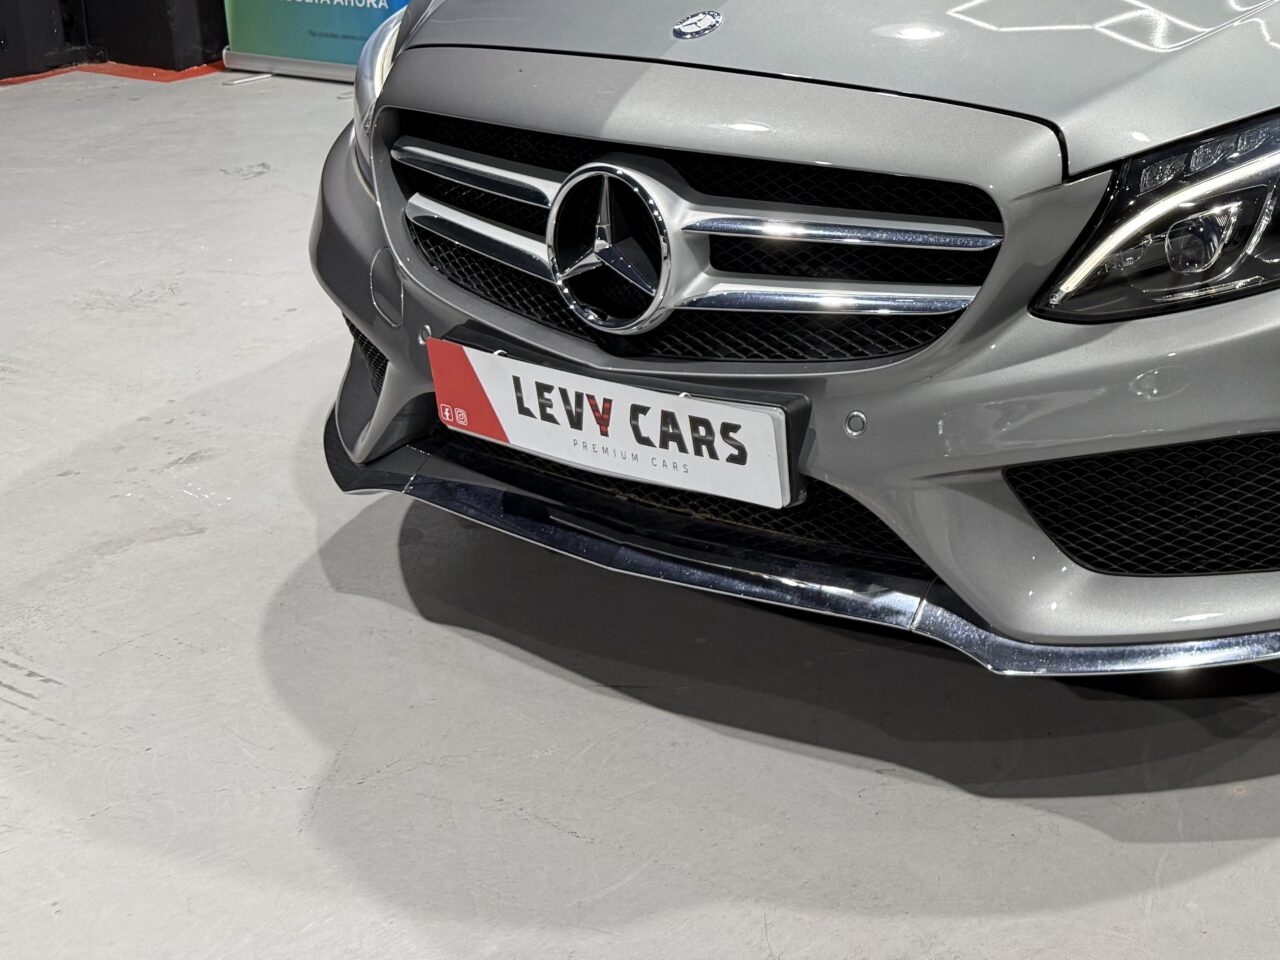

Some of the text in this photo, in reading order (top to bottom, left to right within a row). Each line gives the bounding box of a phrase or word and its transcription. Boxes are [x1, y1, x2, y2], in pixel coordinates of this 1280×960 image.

[511, 374, 748, 466] LEVY CARS
[573, 438, 690, 474] PREMIUM CARS
